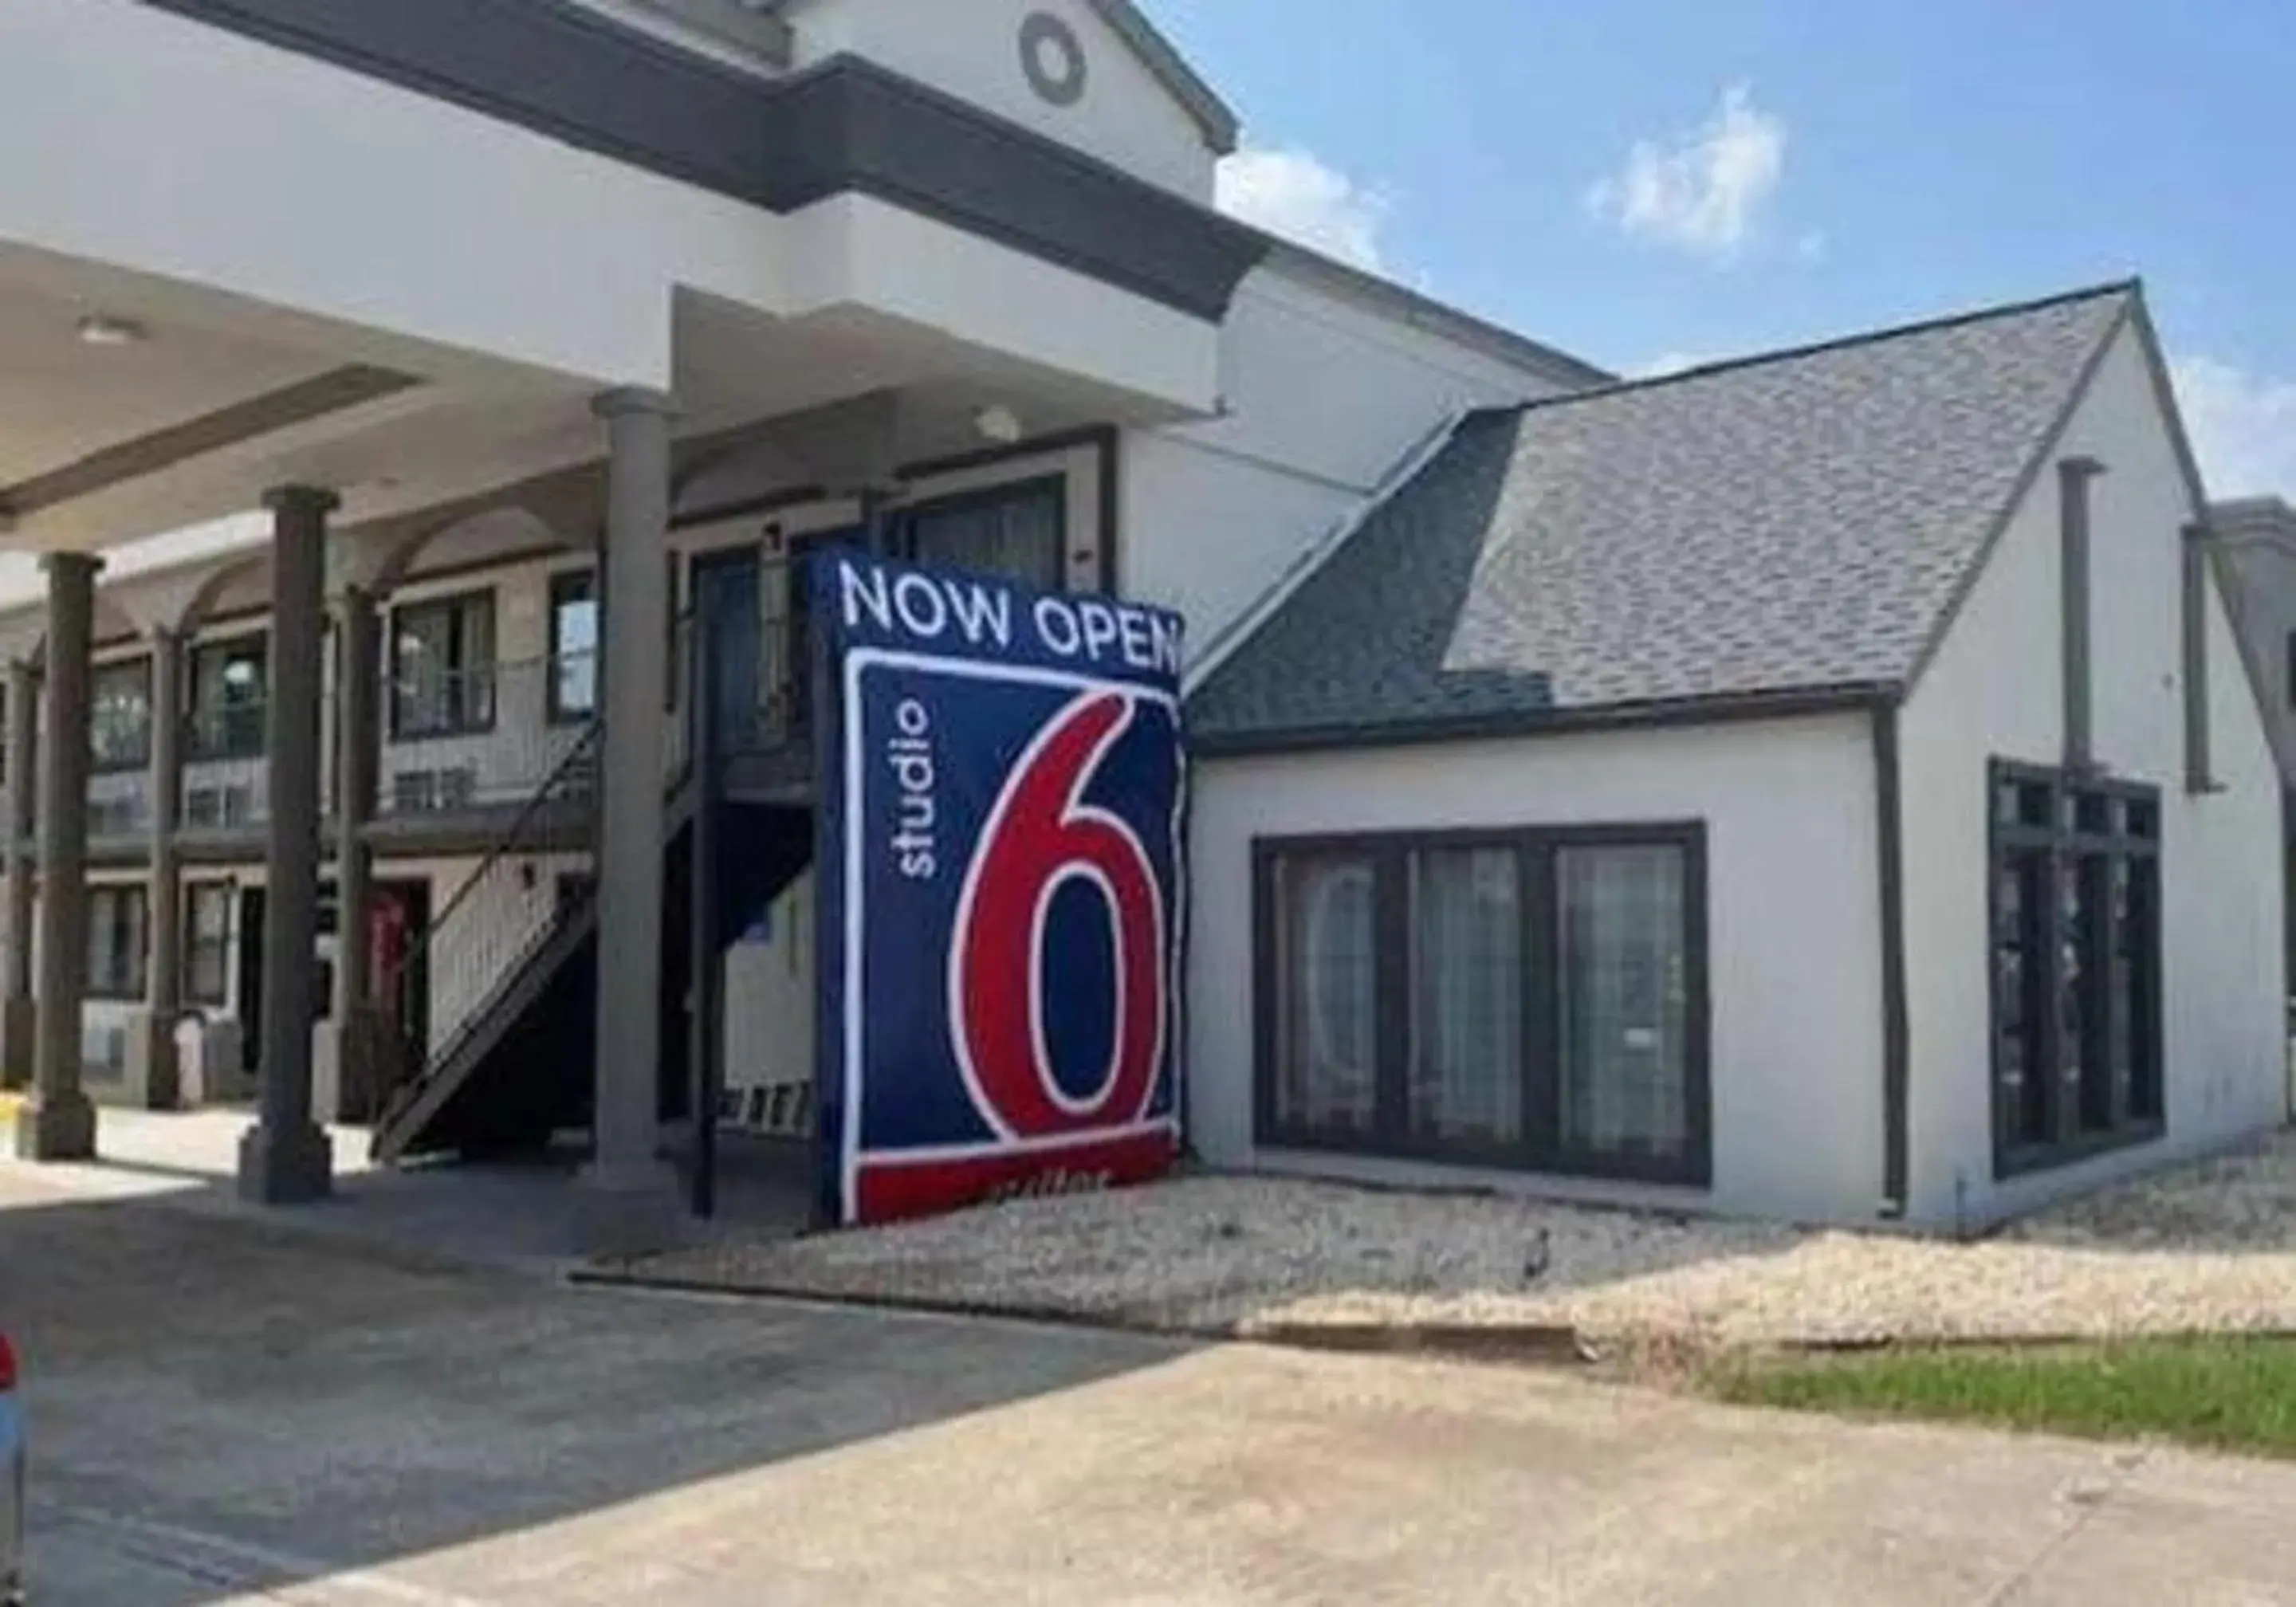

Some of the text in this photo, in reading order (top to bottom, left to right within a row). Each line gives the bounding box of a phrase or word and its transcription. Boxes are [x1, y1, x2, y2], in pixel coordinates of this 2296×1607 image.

[839, 560, 1177, 674] NOW OPEN
[889, 700, 935, 878] studio
[949, 686, 1166, 1143] 6
